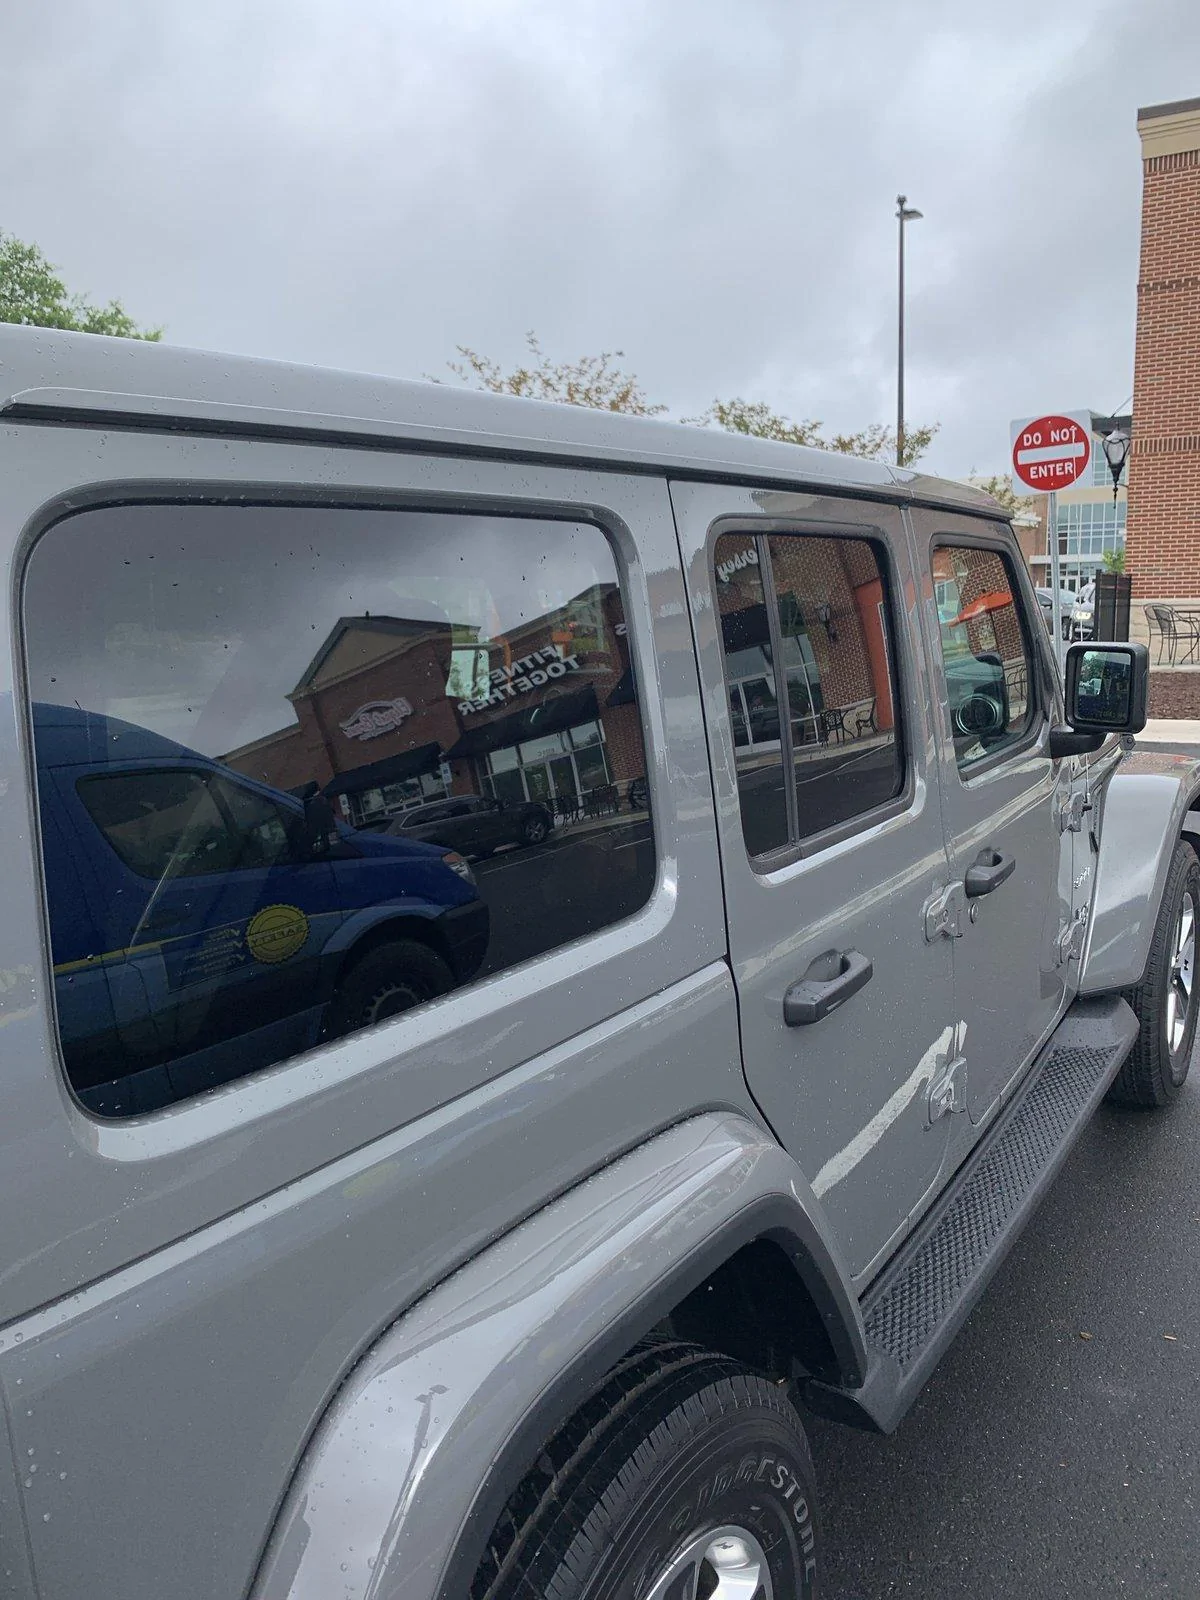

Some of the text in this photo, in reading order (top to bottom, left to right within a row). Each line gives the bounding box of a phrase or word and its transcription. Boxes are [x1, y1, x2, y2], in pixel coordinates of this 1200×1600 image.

[1023, 425, 1077, 447] DO NOT
[1029, 461, 1074, 480] ENTER
